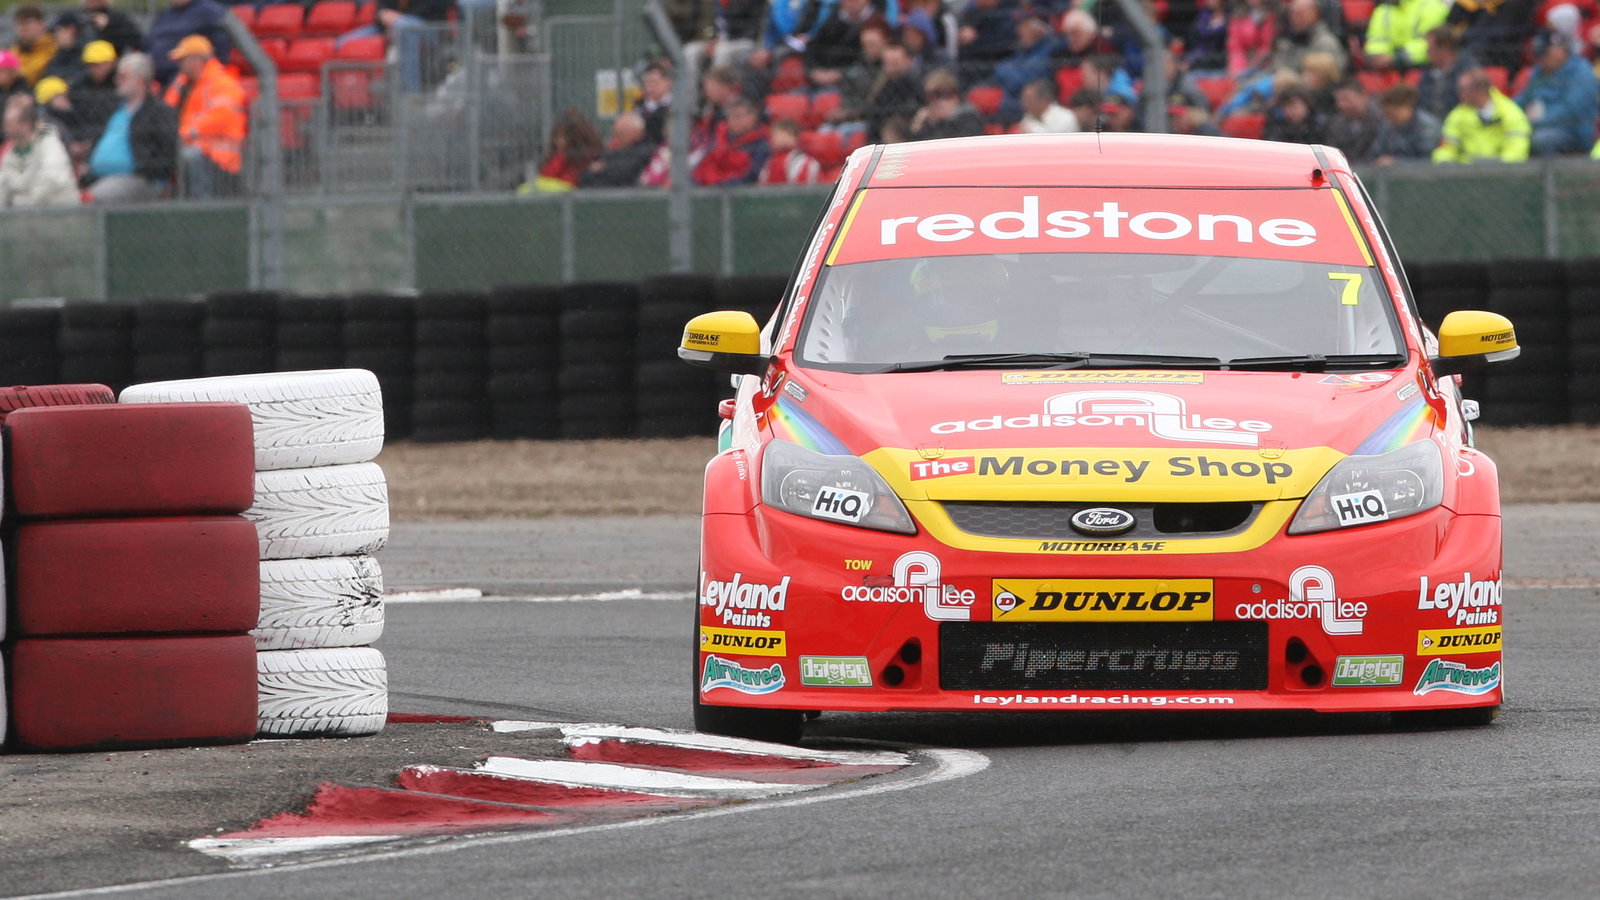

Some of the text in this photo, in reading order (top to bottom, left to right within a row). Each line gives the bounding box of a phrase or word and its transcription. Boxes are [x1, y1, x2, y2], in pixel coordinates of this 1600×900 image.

[880, 195, 1316, 248] redstone
[1328, 272, 1363, 306] 7
[1037, 372, 1200, 380] DUNLOP
[929, 412, 1273, 435] addison lee
[914, 456, 1293, 484] The Money Shop
[815, 490, 862, 518] HiQ
[1336, 494, 1385, 521] HiQ
[1085, 511, 1120, 525] Ford
[1038, 541, 1167, 552] MOTORBASE
[844, 559, 872, 571] TOW
[700, 570, 791, 617] Leyland
[942, 584, 976, 605] lee
[1029, 591, 1212, 612] DUNLOP
[1418, 569, 1502, 619] Leyland
[723, 608, 771, 628] Paints
[1235, 597, 1369, 619] addison lee
[1456, 607, 1498, 626] Paints
[711, 633, 782, 649] DUNLOP
[1437, 631, 1501, 648] DUNLOP
[702, 655, 783, 687] Airwaves
[980, 642, 1241, 678] Pipercross
[1415, 659, 1499, 692] Airwaves
[973, 693, 1235, 706] leylandracing.com
